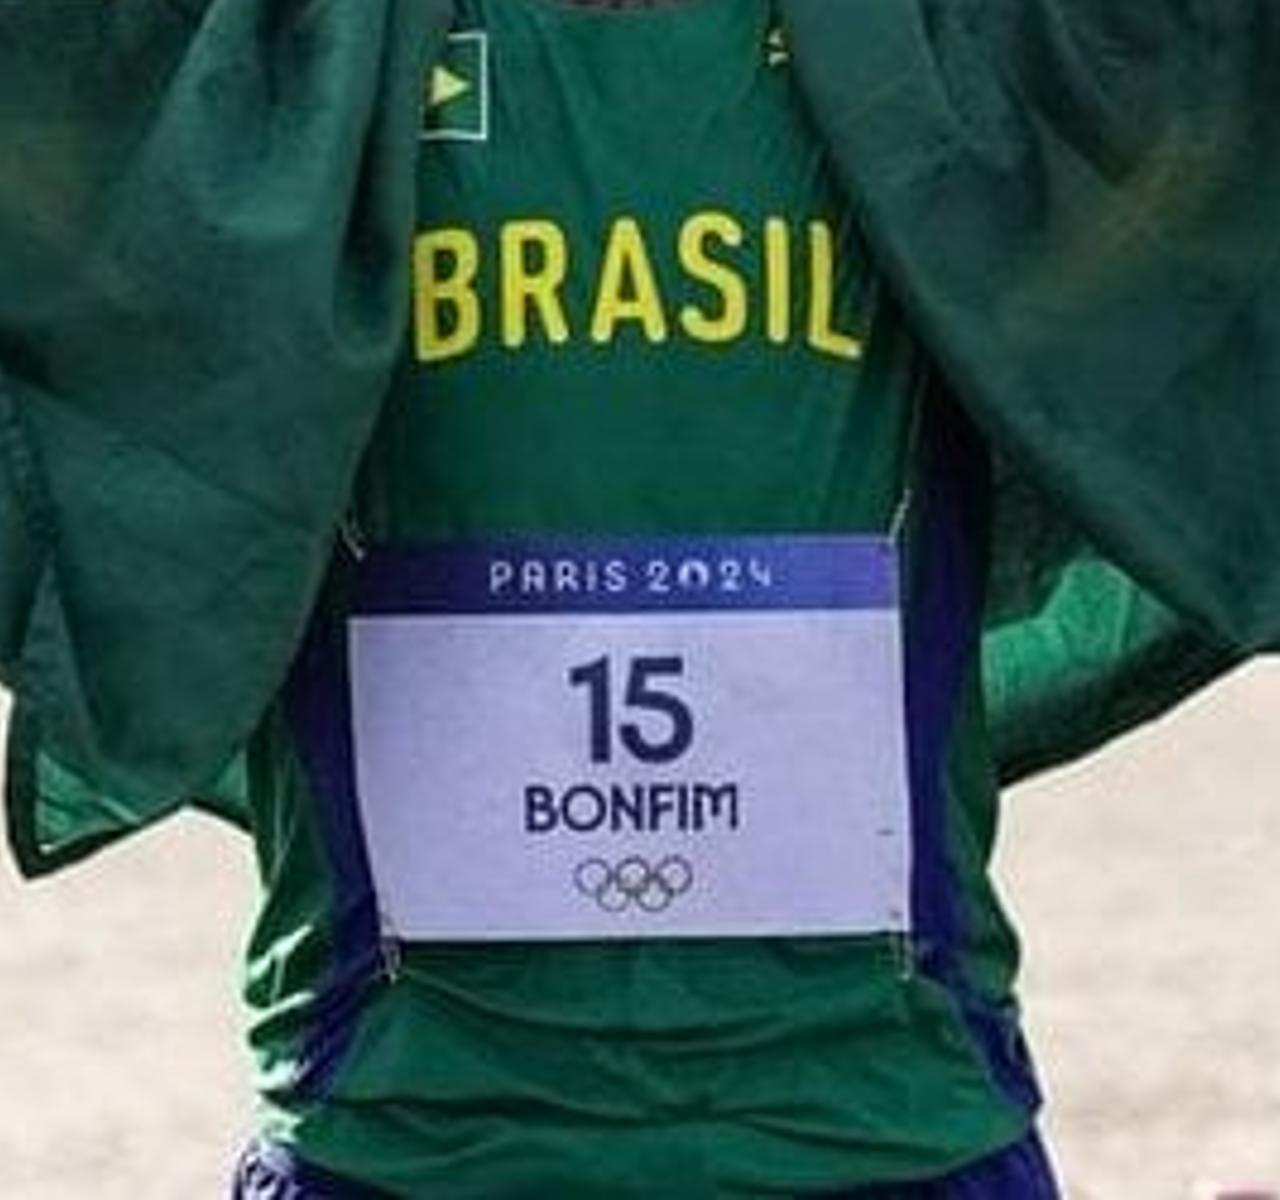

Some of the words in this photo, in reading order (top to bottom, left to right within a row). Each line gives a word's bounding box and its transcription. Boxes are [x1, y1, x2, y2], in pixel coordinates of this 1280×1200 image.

[413, 212, 863, 362] BRASIL
[489, 559, 627, 593] PARIS
[646, 559, 774, 593] 2024
[568, 653, 695, 765] 15
[524, 781, 739, 833] BONFIM
